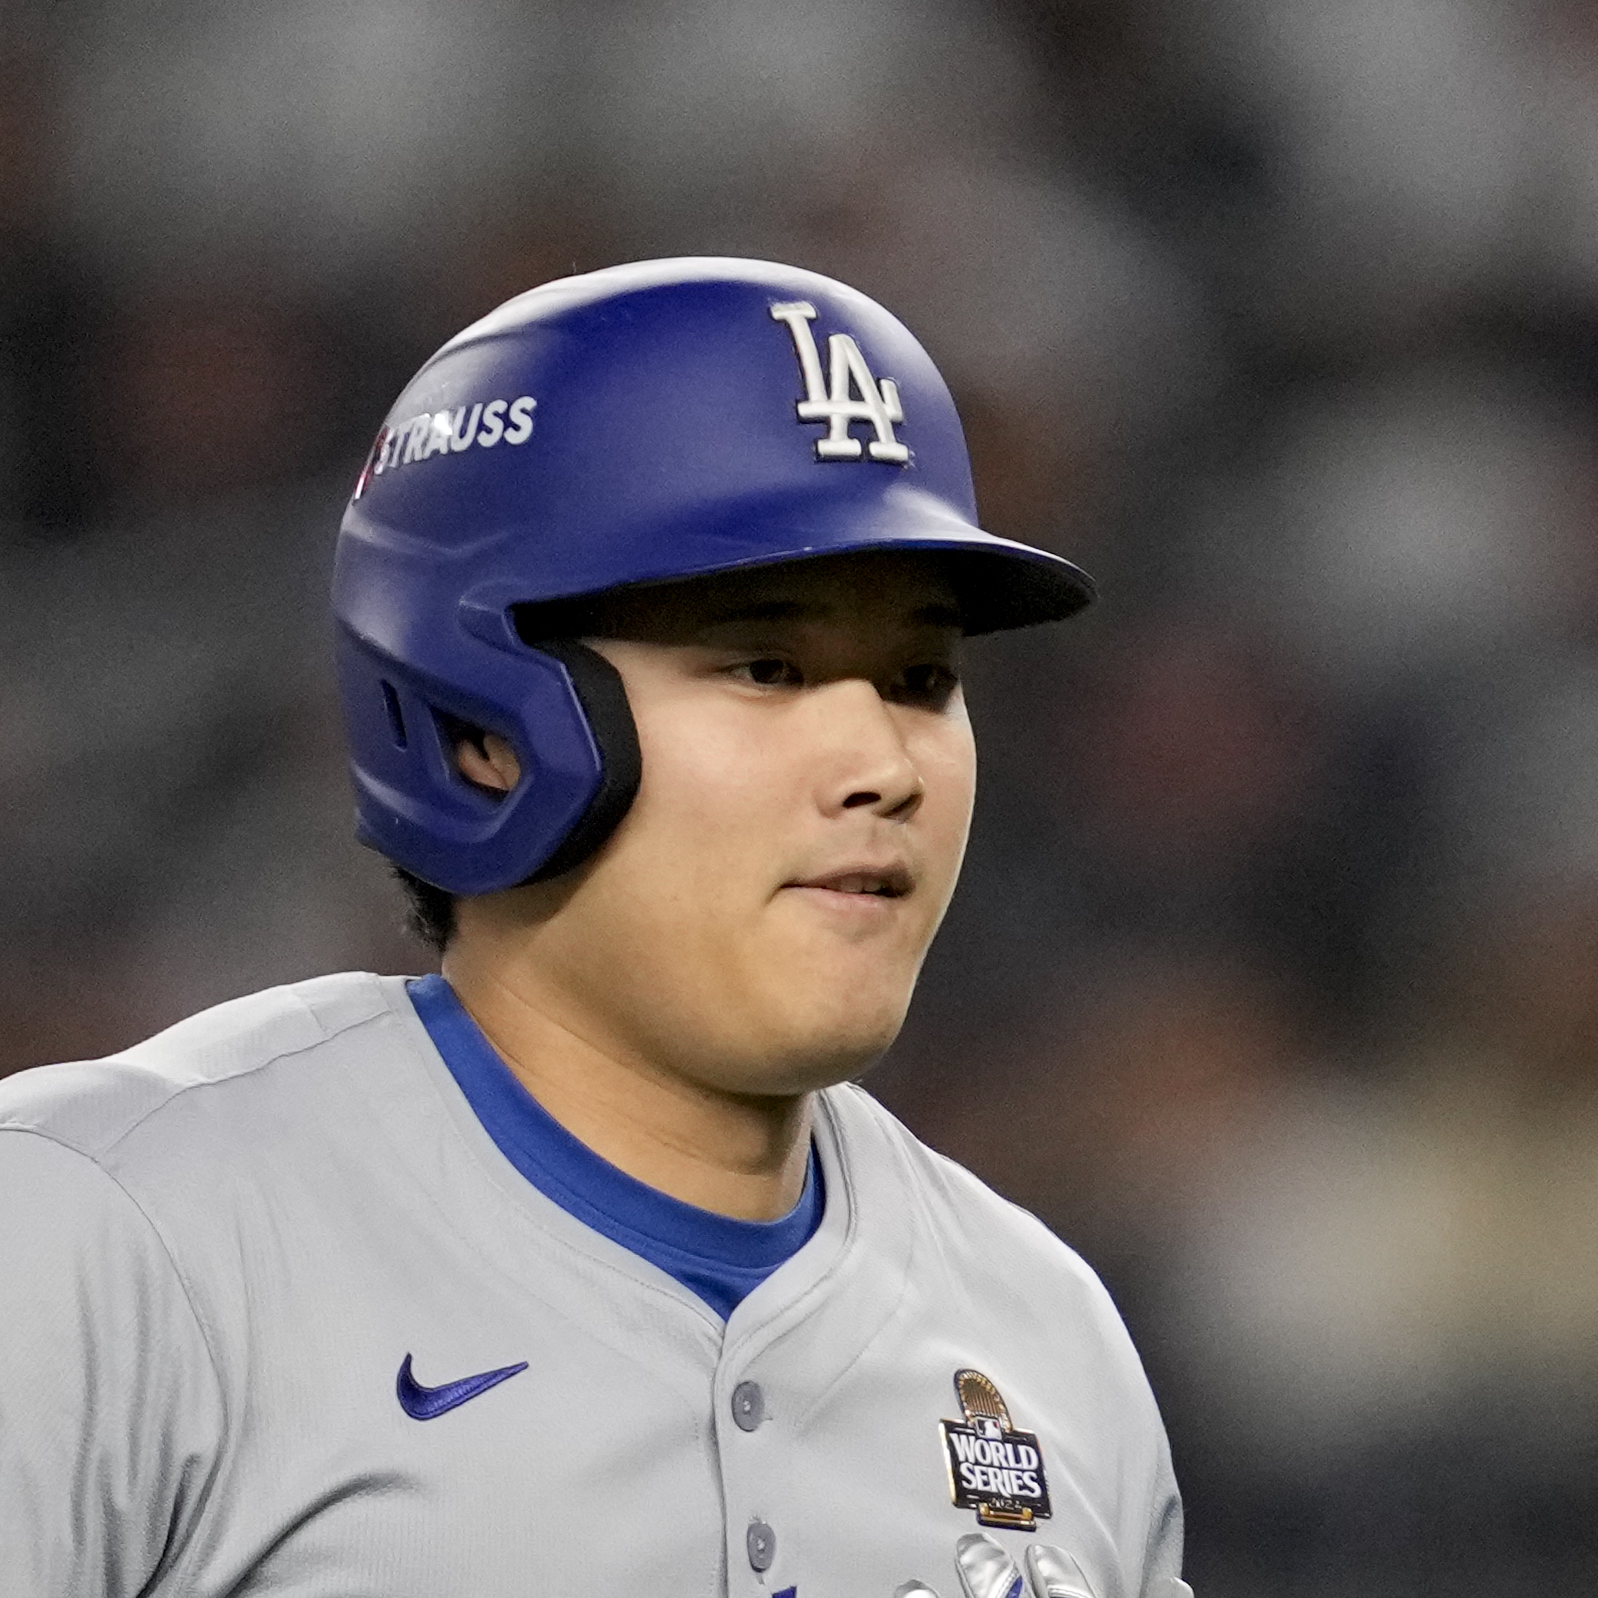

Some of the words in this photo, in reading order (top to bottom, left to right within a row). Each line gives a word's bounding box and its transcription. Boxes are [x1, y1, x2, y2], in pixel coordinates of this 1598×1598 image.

[769, 301, 909, 464] LA
[373, 396, 538, 476] STRAUSS
[949, 1433, 1040, 1471] WORLD
[959, 1462, 1042, 1499] SERIES
